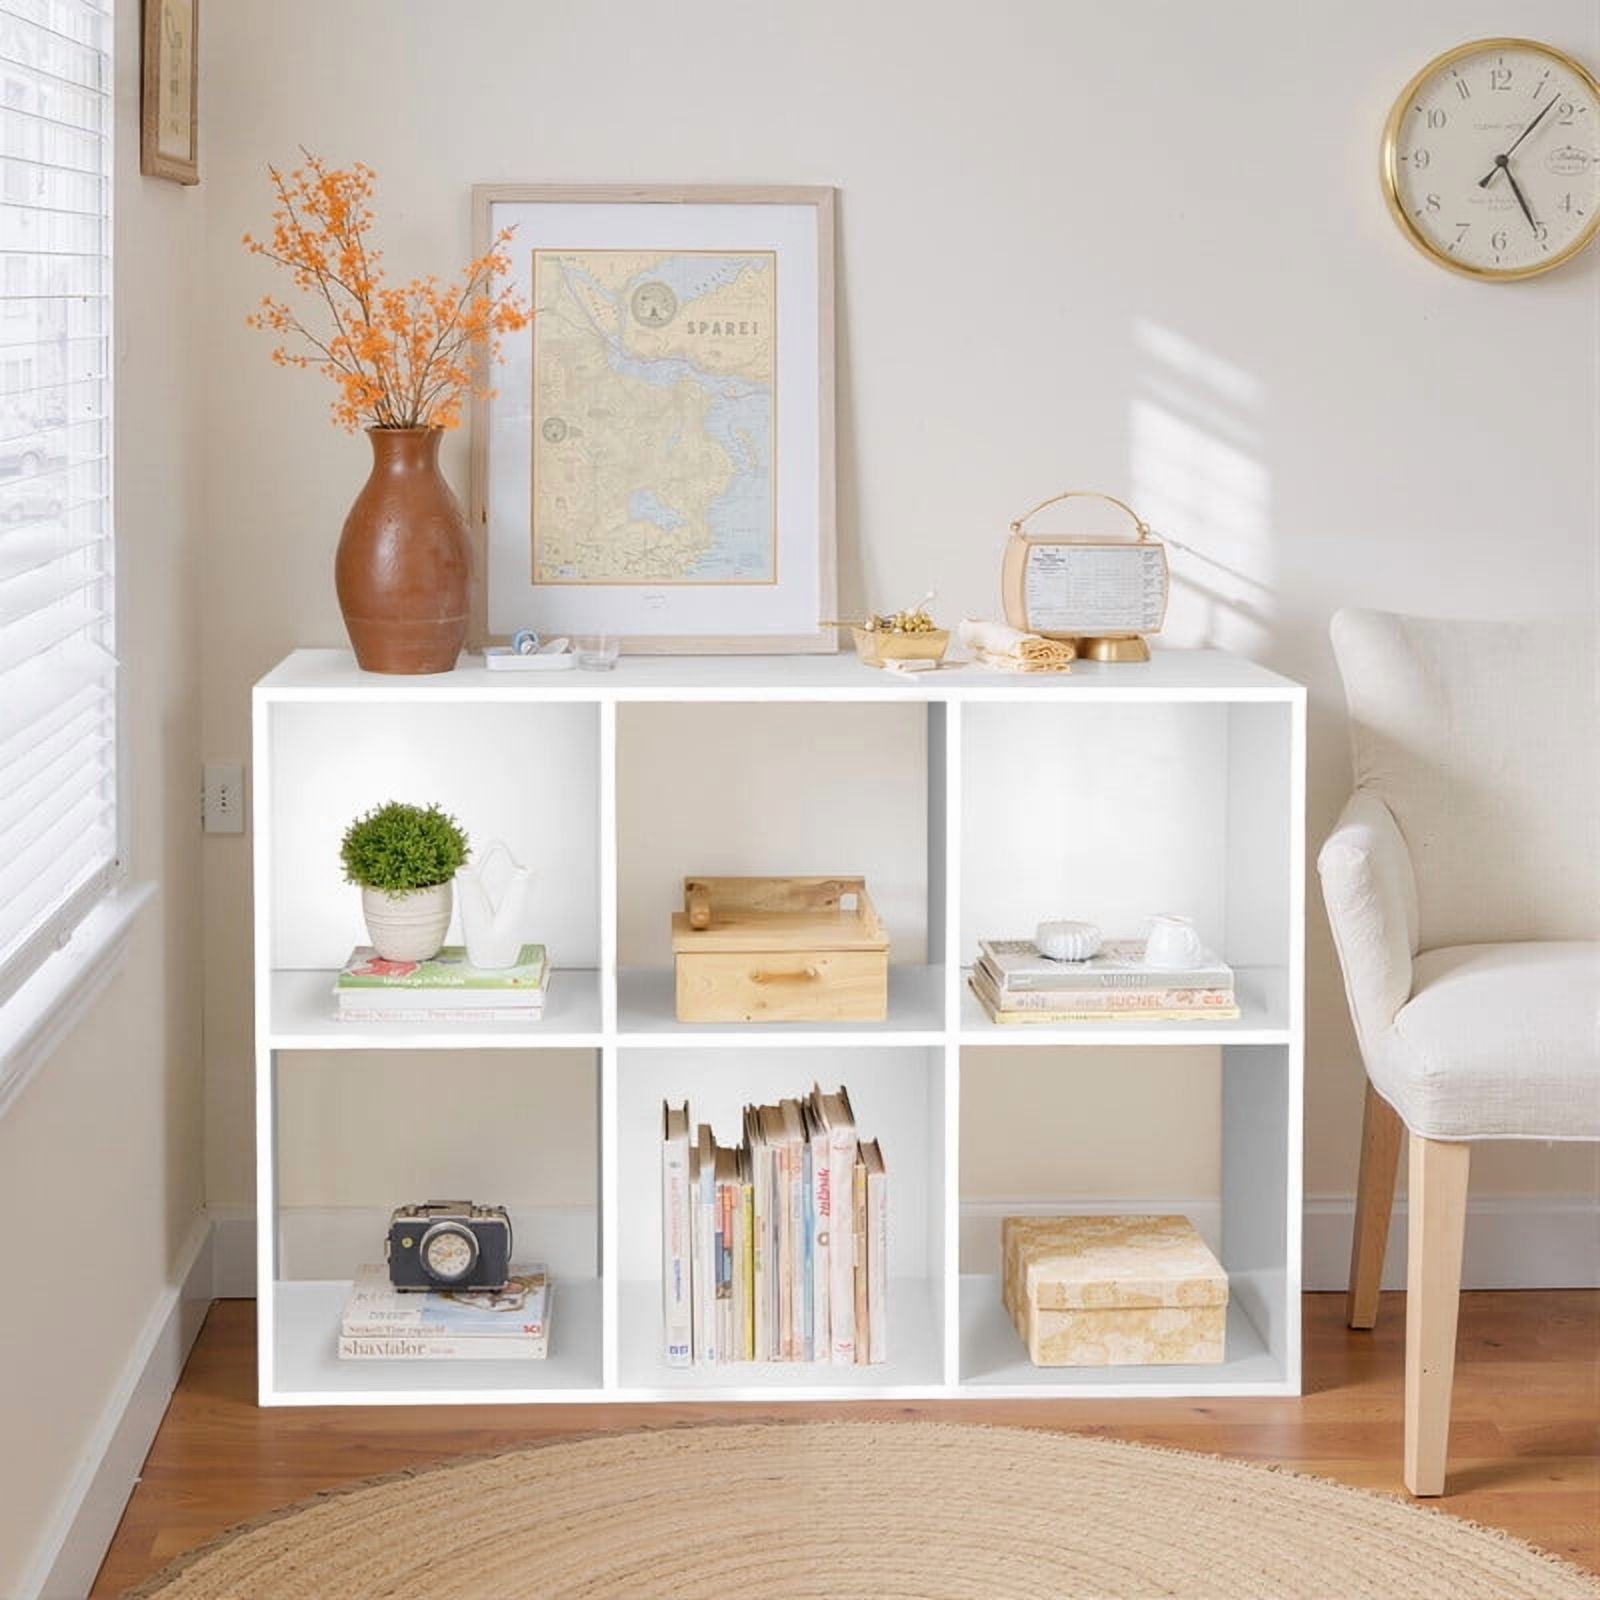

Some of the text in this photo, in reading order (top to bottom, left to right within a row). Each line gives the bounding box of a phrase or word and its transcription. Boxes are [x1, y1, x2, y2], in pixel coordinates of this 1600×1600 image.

[1490, 69, 1512, 91] 12
[1427, 109, 1447, 129] 10
[1558, 103, 1574, 125] 2
[1414, 149, 1430, 169] 9
[1426, 194, 1441, 213] 8
[1557, 192, 1572, 213] 4
[1455, 223, 1470, 243] 7
[1491, 232, 1507, 250] 6
